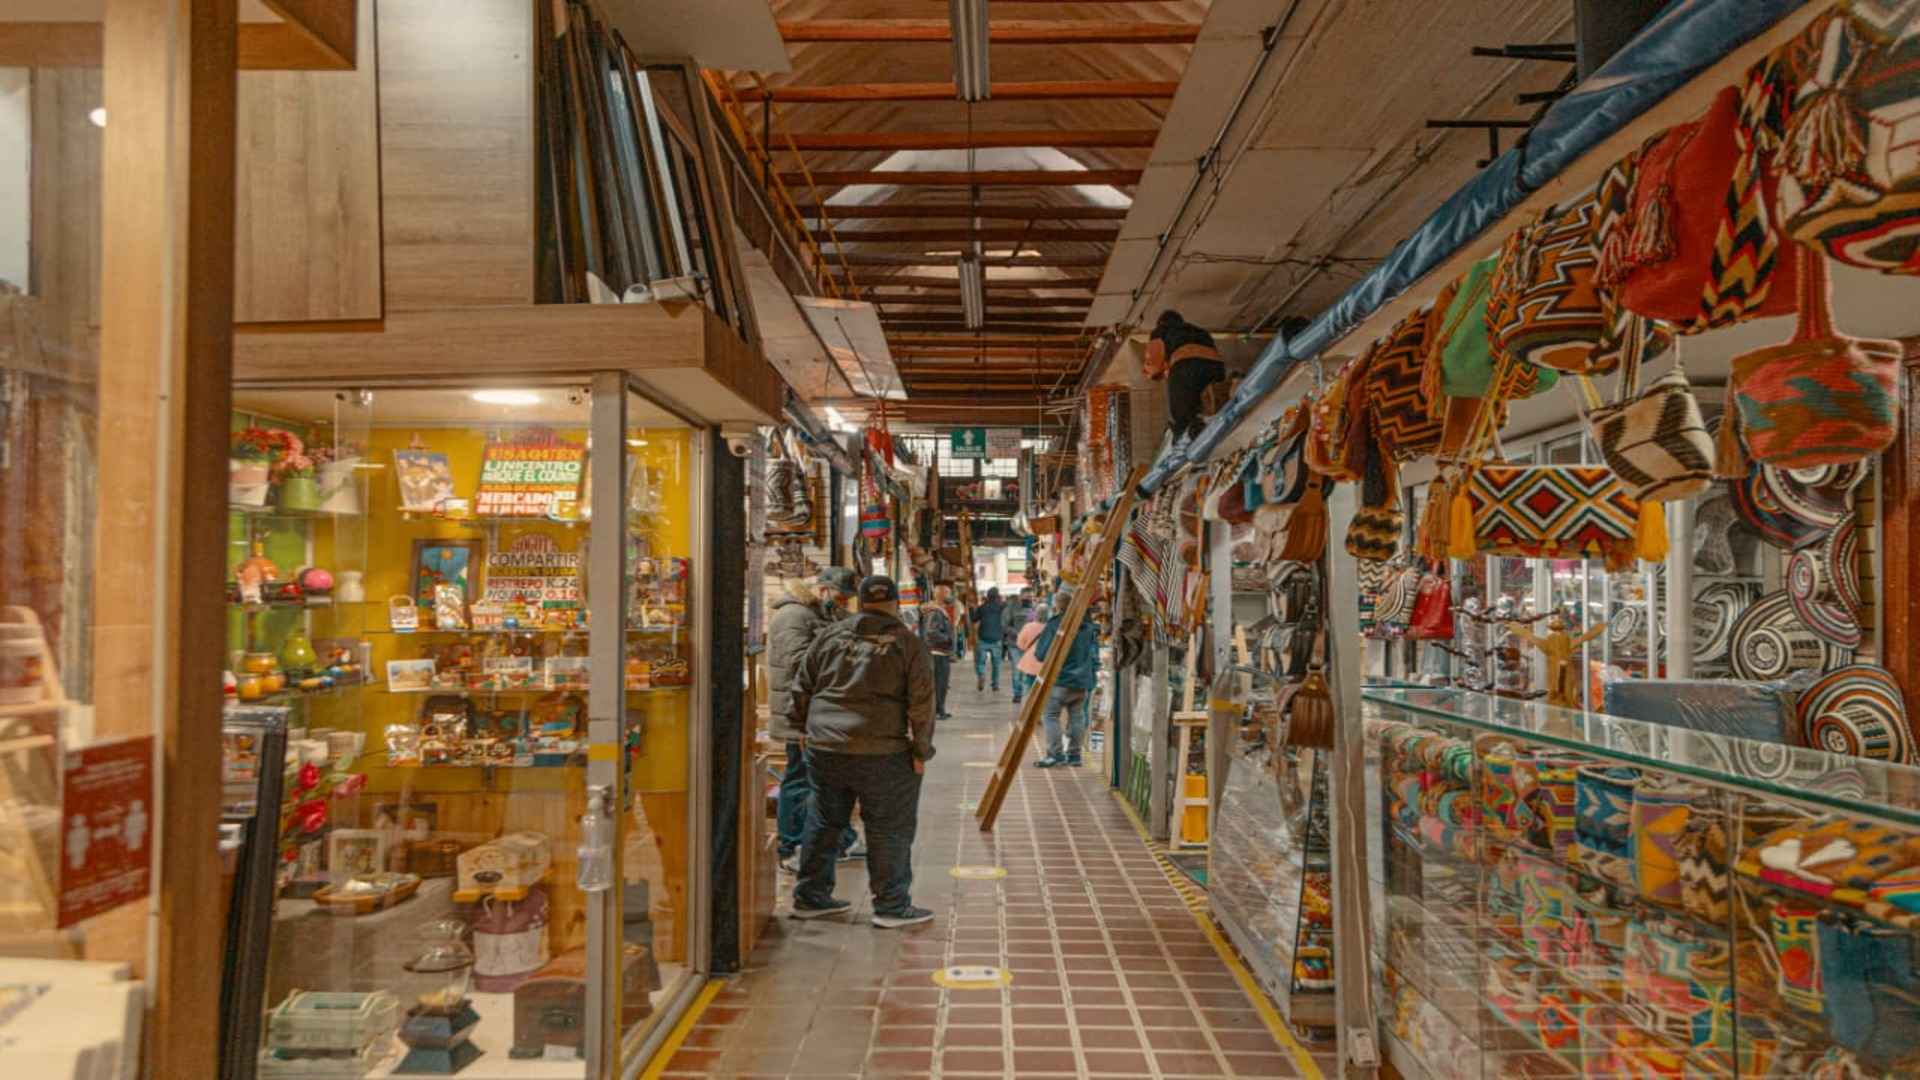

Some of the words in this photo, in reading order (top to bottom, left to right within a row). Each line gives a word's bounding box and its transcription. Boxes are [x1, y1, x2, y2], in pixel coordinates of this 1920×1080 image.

[480, 491, 553, 503] MERCADO
[489, 553, 578, 566] COMPARTIR
[488, 579, 544, 589] RESTREPO
